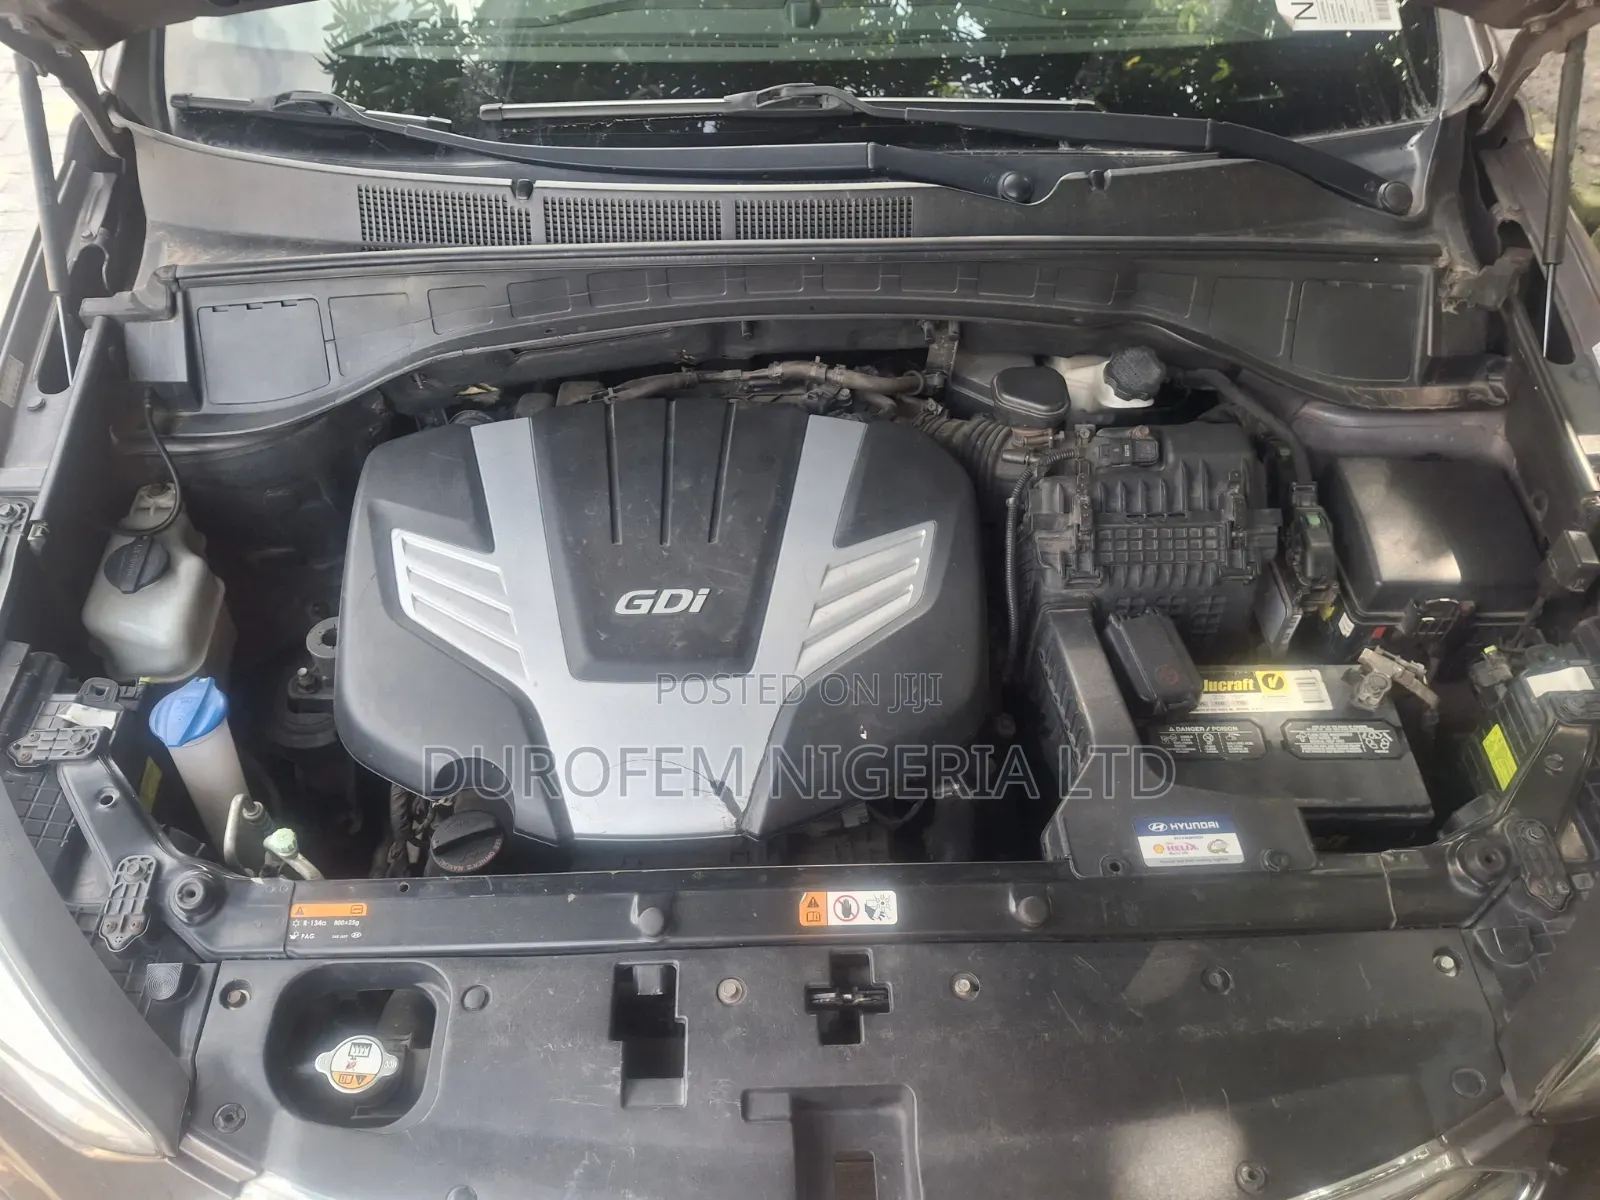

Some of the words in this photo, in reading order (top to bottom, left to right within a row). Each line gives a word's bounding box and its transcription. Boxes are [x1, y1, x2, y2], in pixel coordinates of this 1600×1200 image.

[614, 588, 711, 615] GDi
[1203, 678, 1256, 692] lucraft
[1170, 821, 1220, 831] HYUNDAI
[1166, 844, 1199, 852] HELIX
[466, 851, 496, 871] OWNER'S
